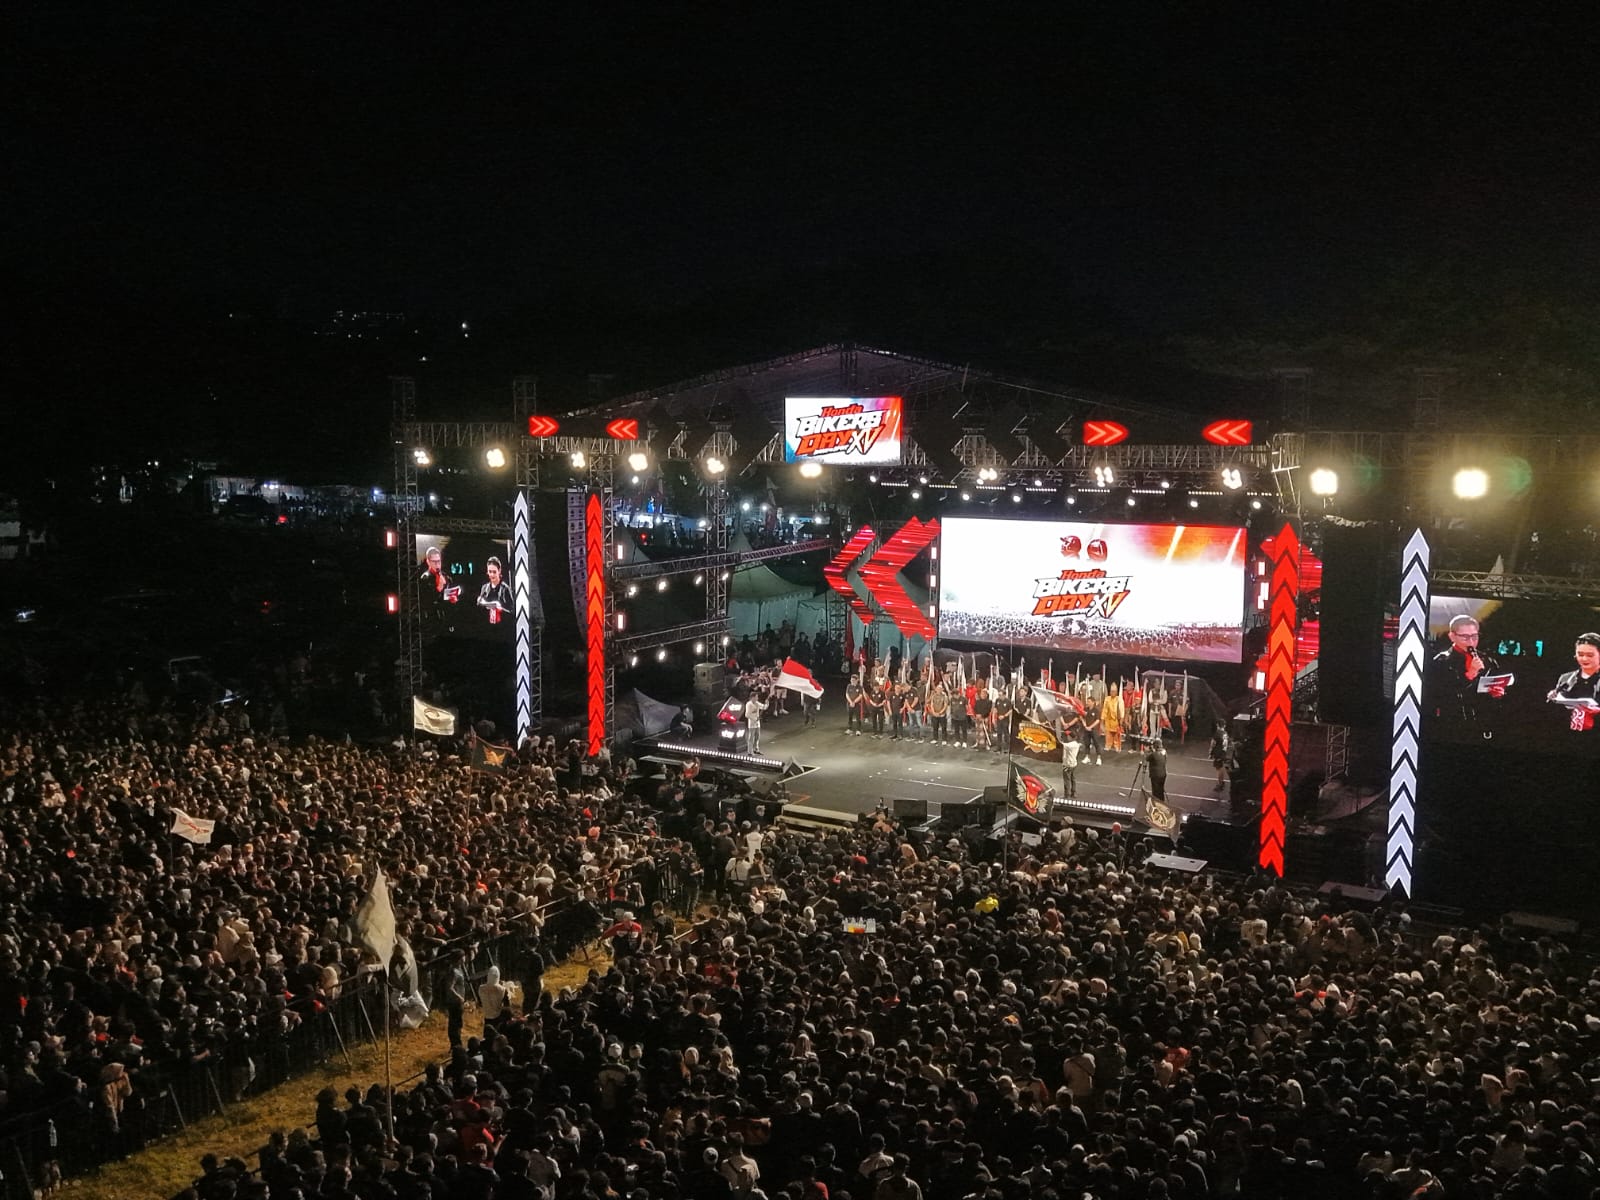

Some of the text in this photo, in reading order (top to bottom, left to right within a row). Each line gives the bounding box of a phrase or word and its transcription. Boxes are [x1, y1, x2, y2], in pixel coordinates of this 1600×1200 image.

[821, 403, 863, 417] Honda
[796, 410, 886, 438] BIKERS
[795, 425, 885, 456] DAY XV
[1060, 568, 1107, 580] Honda
[1033, 576, 1129, 598] BIKERS
[1032, 590, 1130, 619] DAY XV
